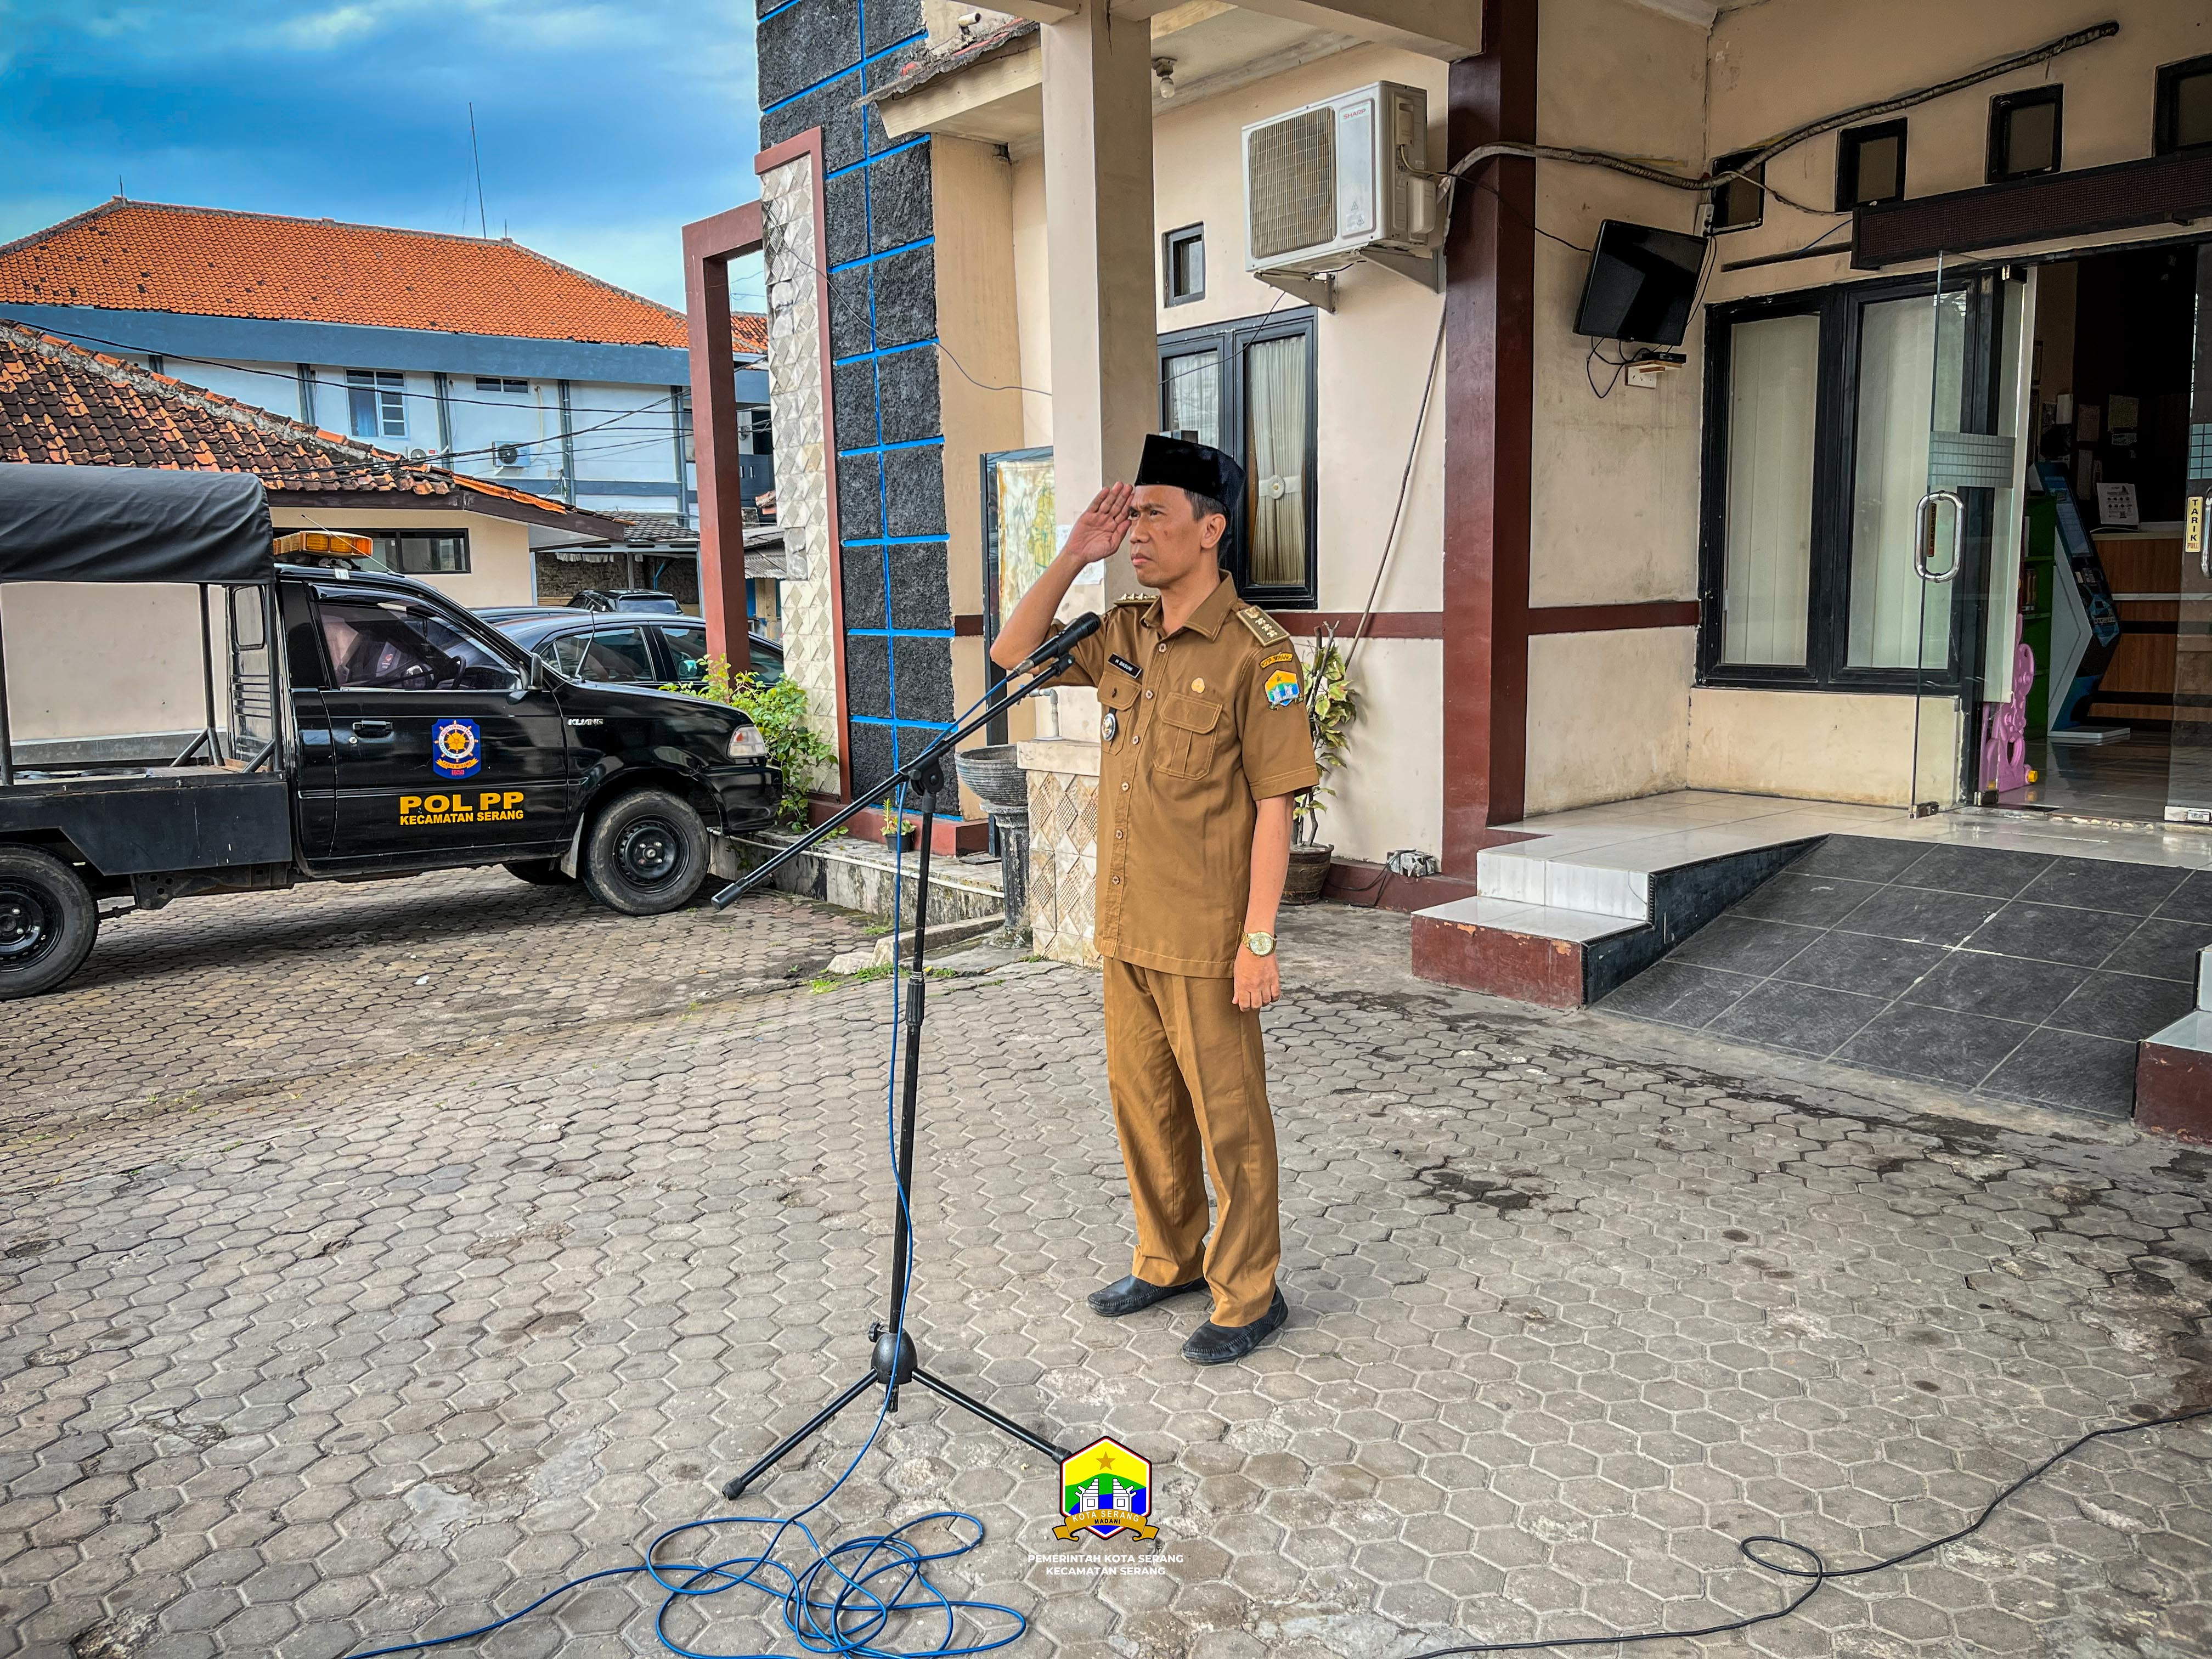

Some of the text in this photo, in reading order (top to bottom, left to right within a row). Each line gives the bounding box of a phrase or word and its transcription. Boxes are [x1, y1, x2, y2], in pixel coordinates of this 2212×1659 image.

[1342, 108, 1366, 119] SHARP
[2190, 499, 2199, 541] TARIK
[400, 792, 524, 814] POL PP
[400, 810, 524, 826] KECAMATAN SERANG
